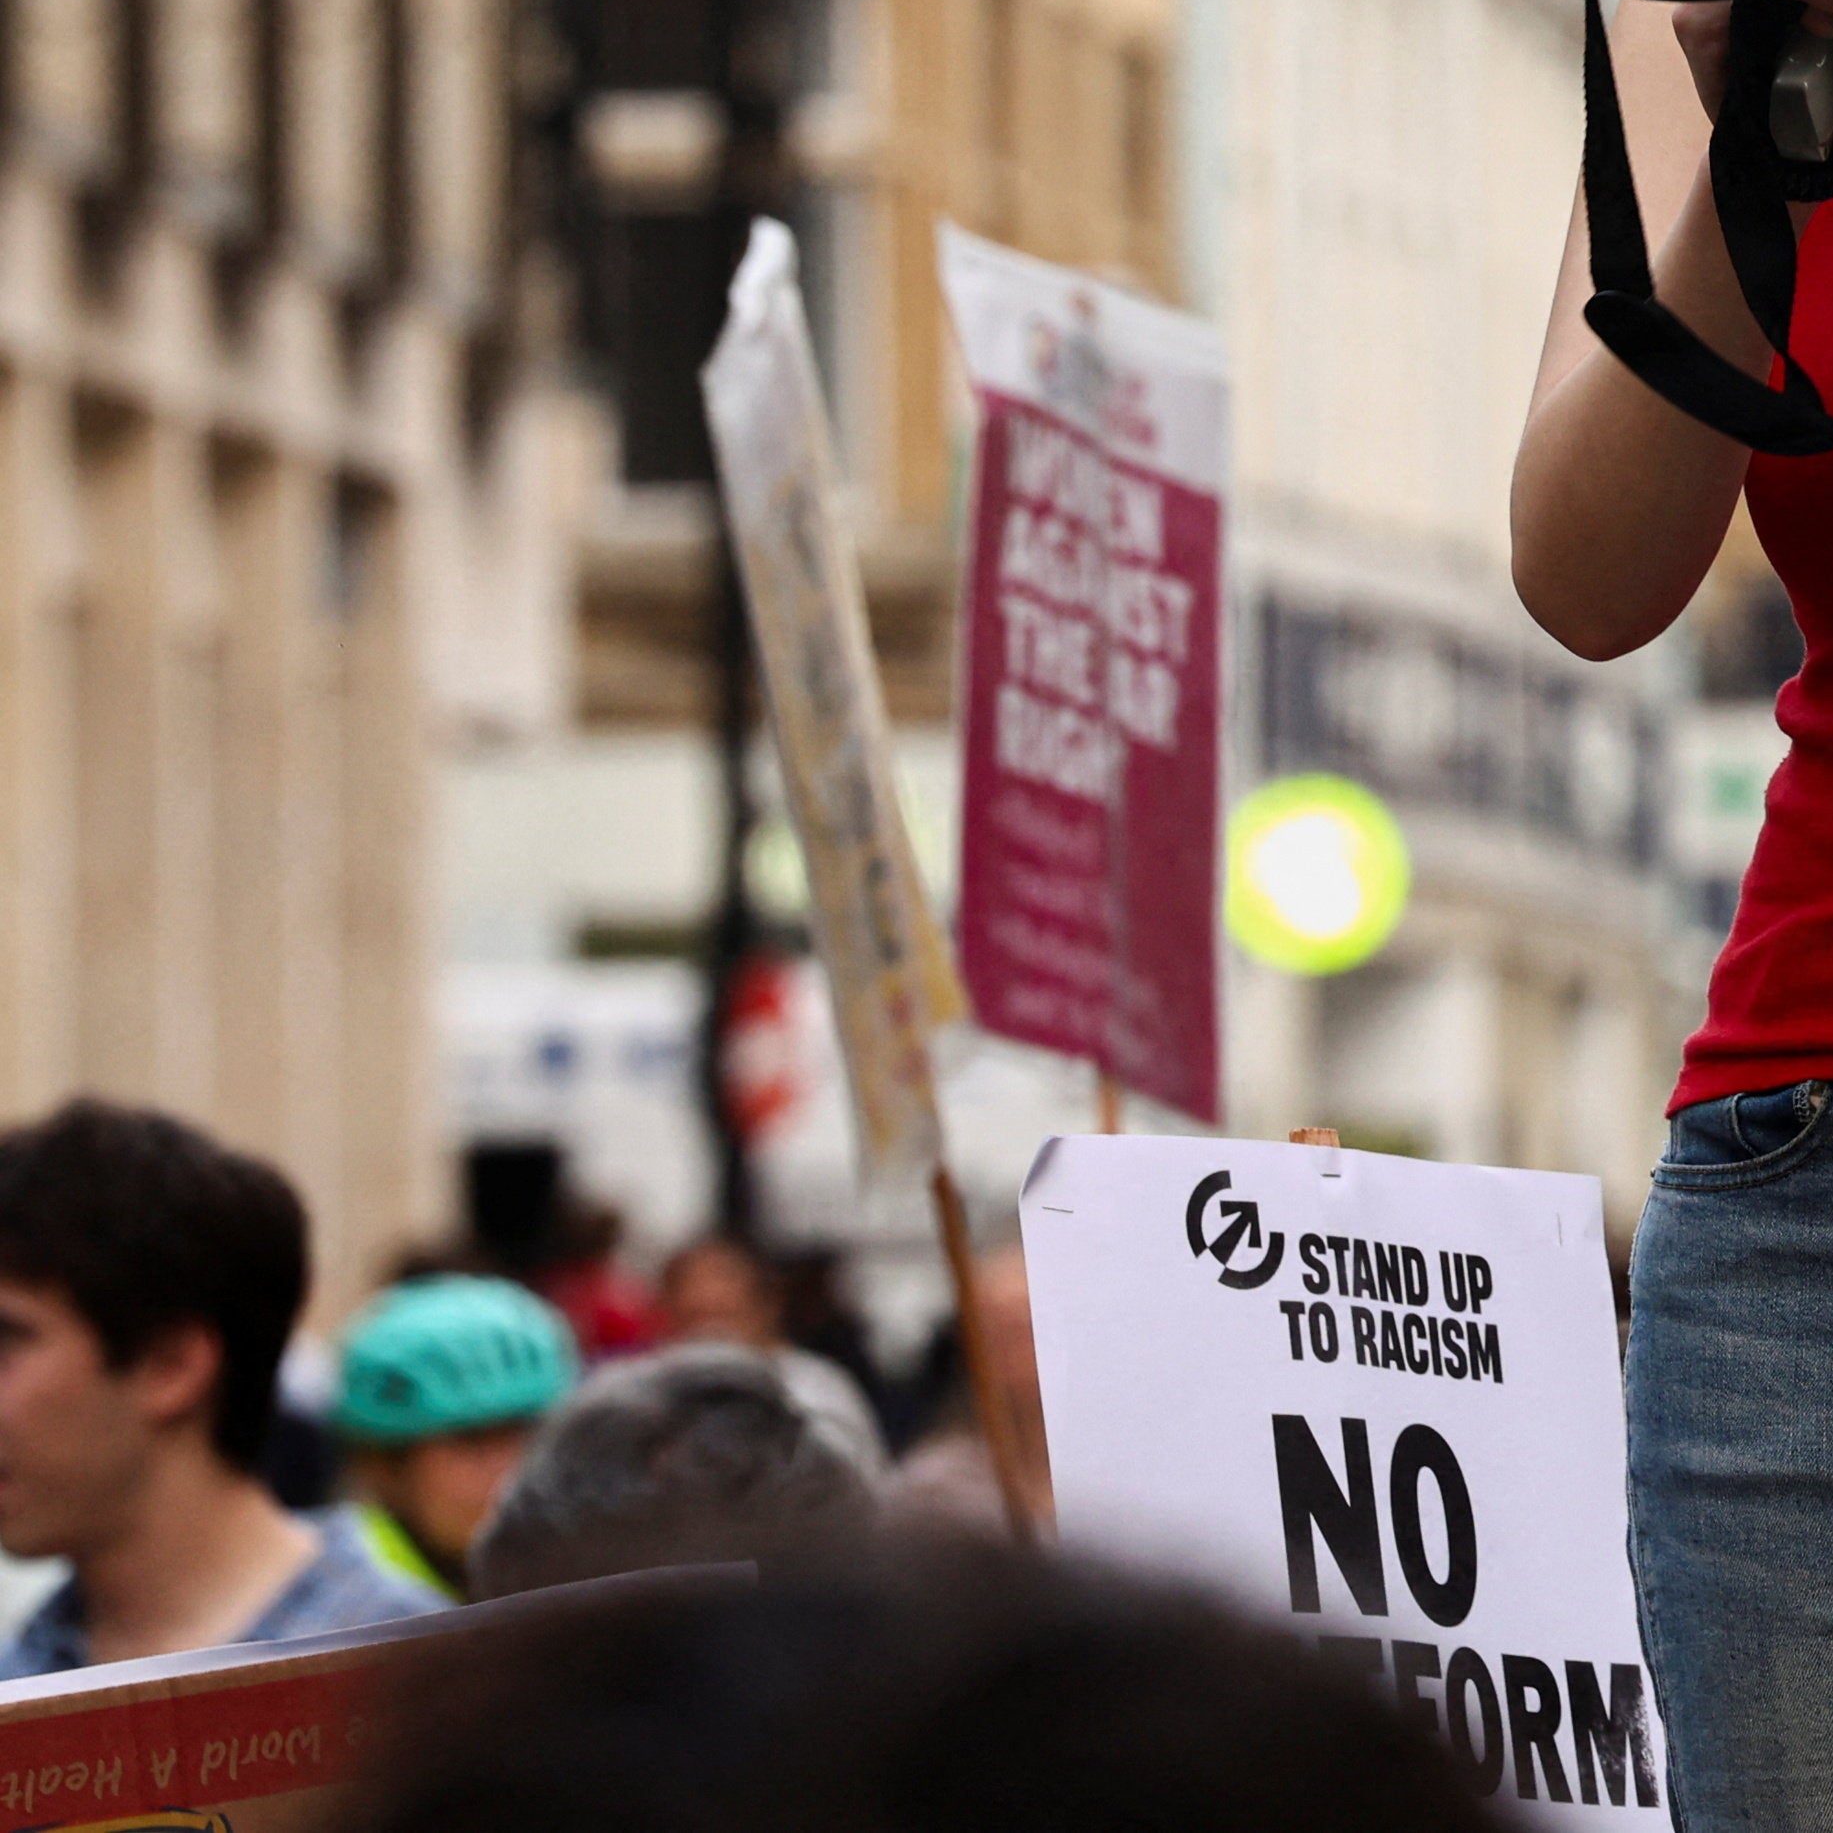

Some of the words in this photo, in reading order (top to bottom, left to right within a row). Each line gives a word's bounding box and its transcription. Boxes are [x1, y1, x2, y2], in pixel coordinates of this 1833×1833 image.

[1299, 1232, 1429, 1306] STAND
[1439, 1251, 1493, 1315] UP
[1279, 1299, 1339, 1364] TO
[1350, 1305, 1504, 1385] RACISM
[1270, 1412, 1478, 1629] NO
[0, 1756, 123, 1815] Healt
[149, 1746, 178, 1789] A
[202, 1721, 321, 1785] World
